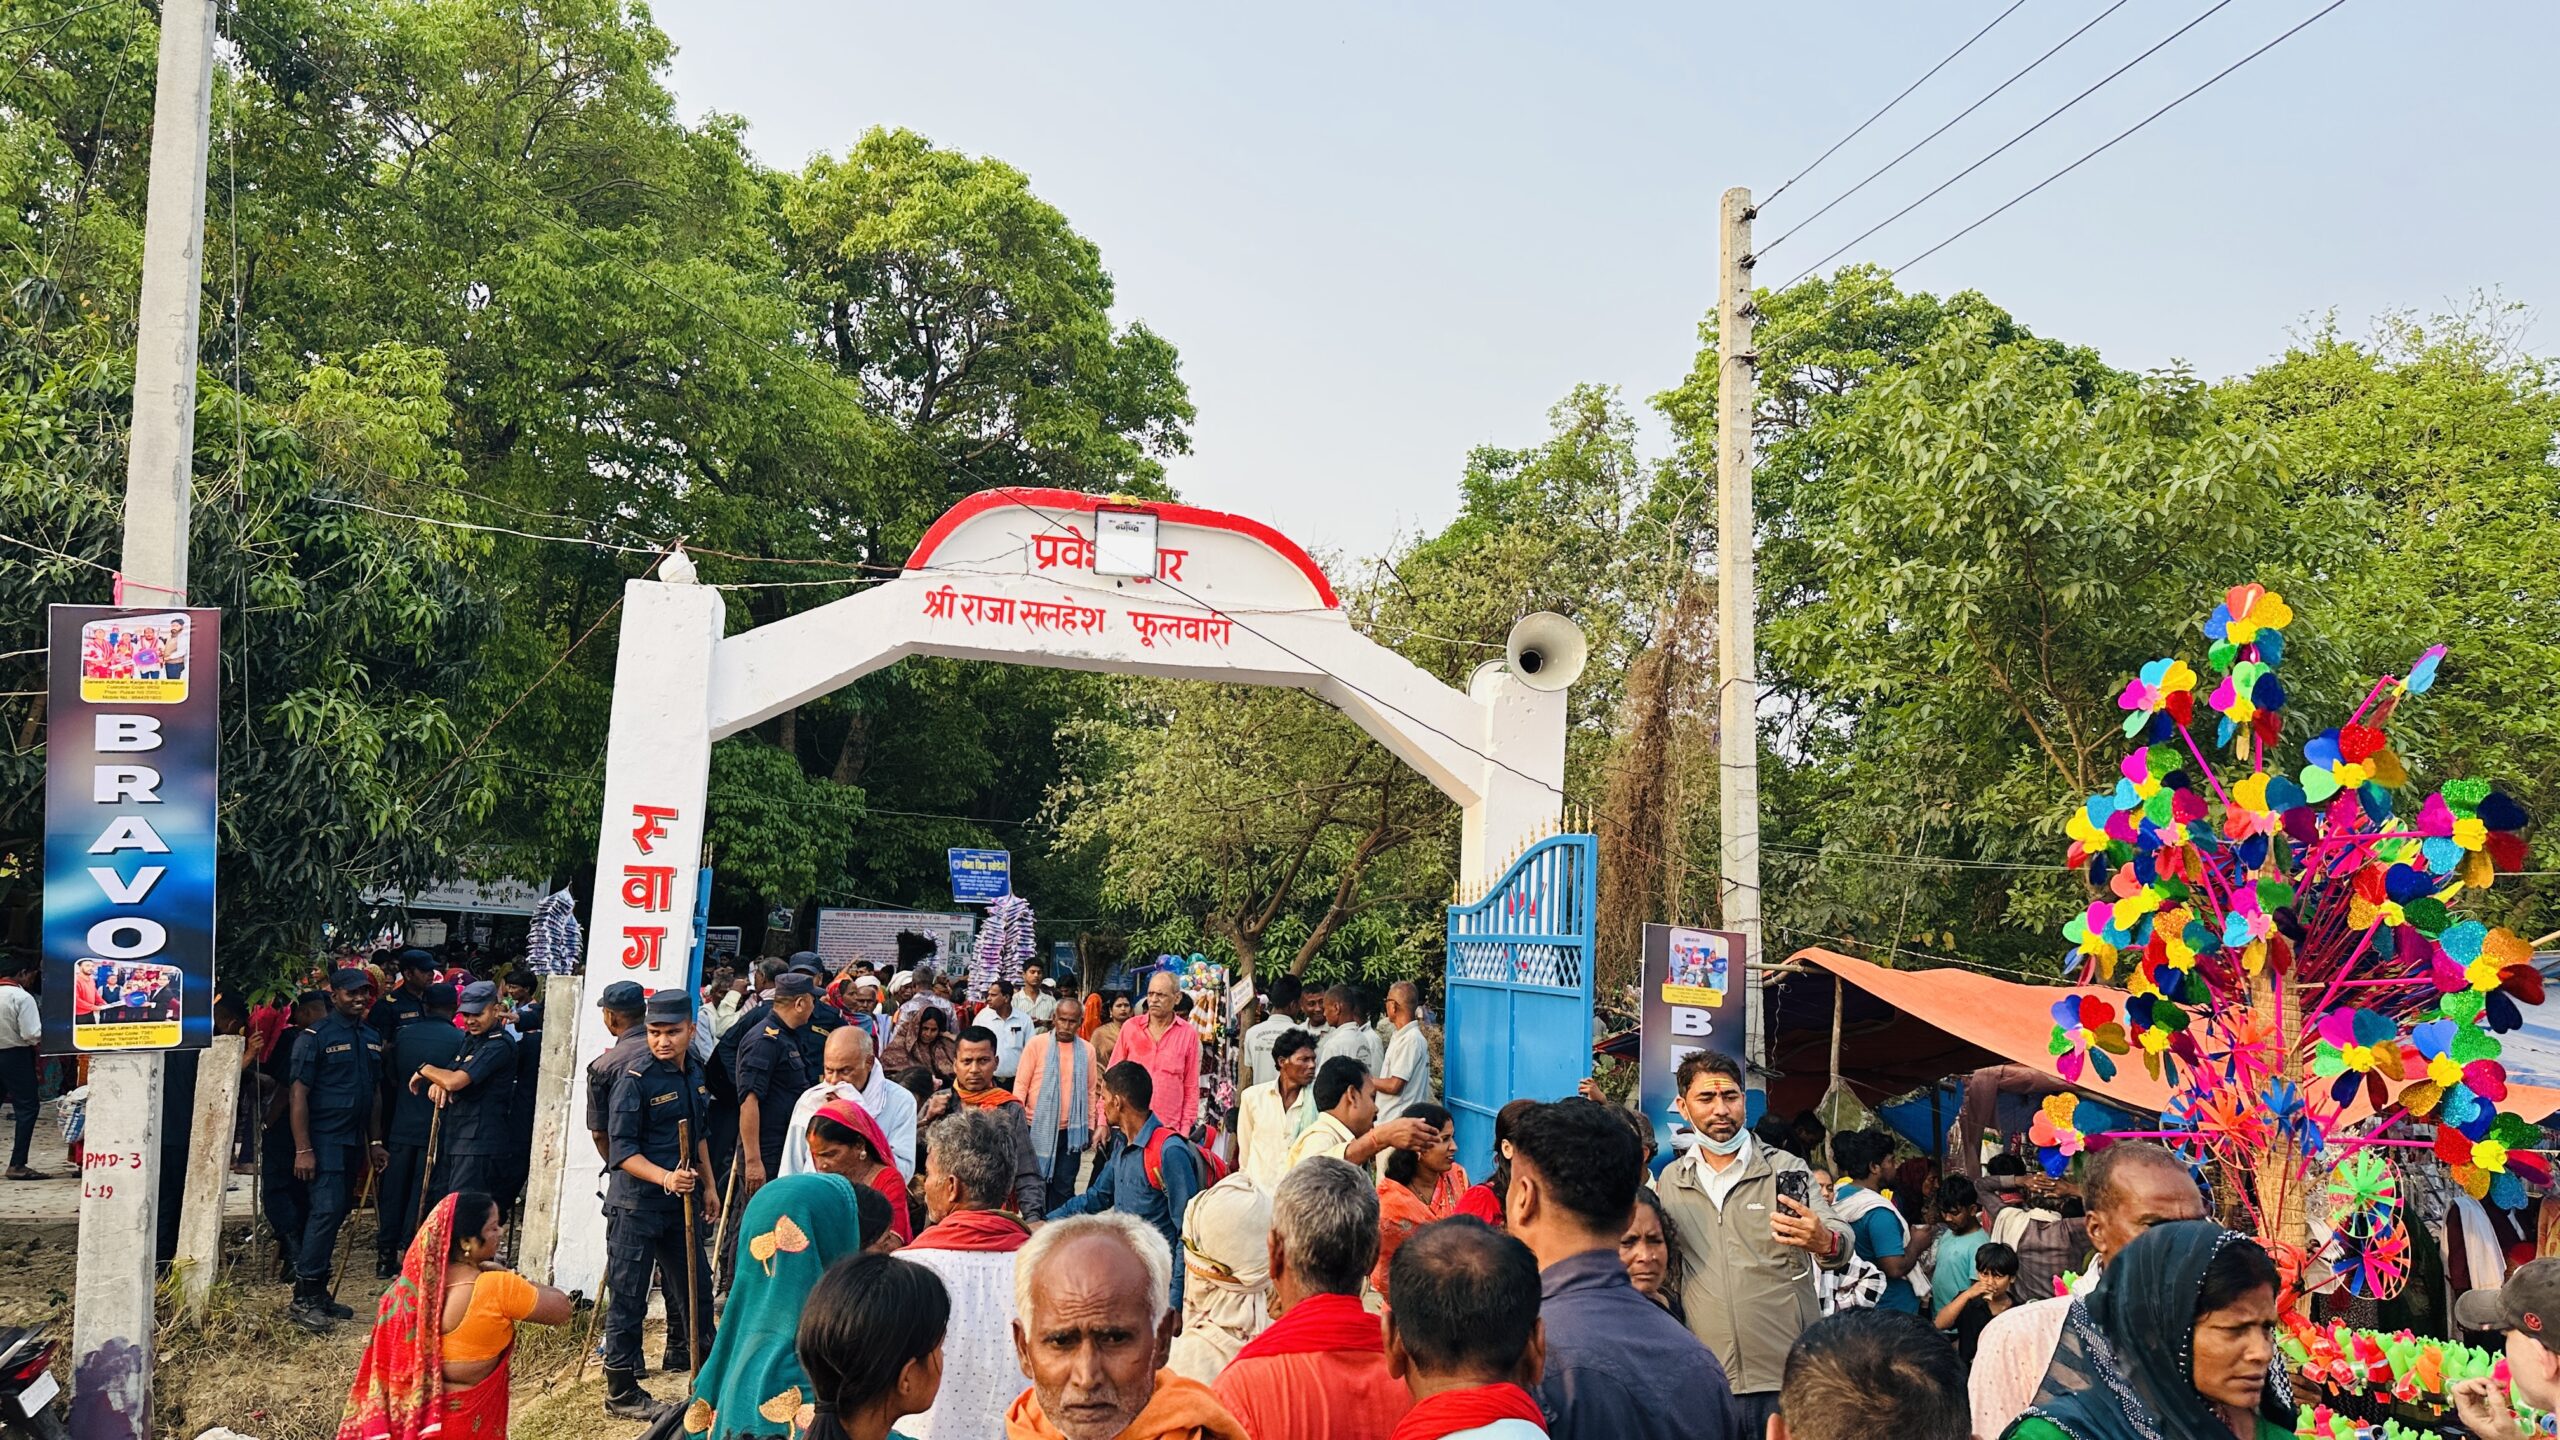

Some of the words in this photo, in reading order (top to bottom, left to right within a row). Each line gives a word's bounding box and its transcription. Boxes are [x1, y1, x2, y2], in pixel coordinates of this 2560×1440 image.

[922, 585, 958, 619] श्री
[961, 593, 1017, 626] राजा
[1020, 595, 1107, 636] सलहेश
[1127, 610, 1233, 650] फूलवारी
[87, 713, 171, 958] BRAVO
[84, 1182, 114, 1200] L-19
